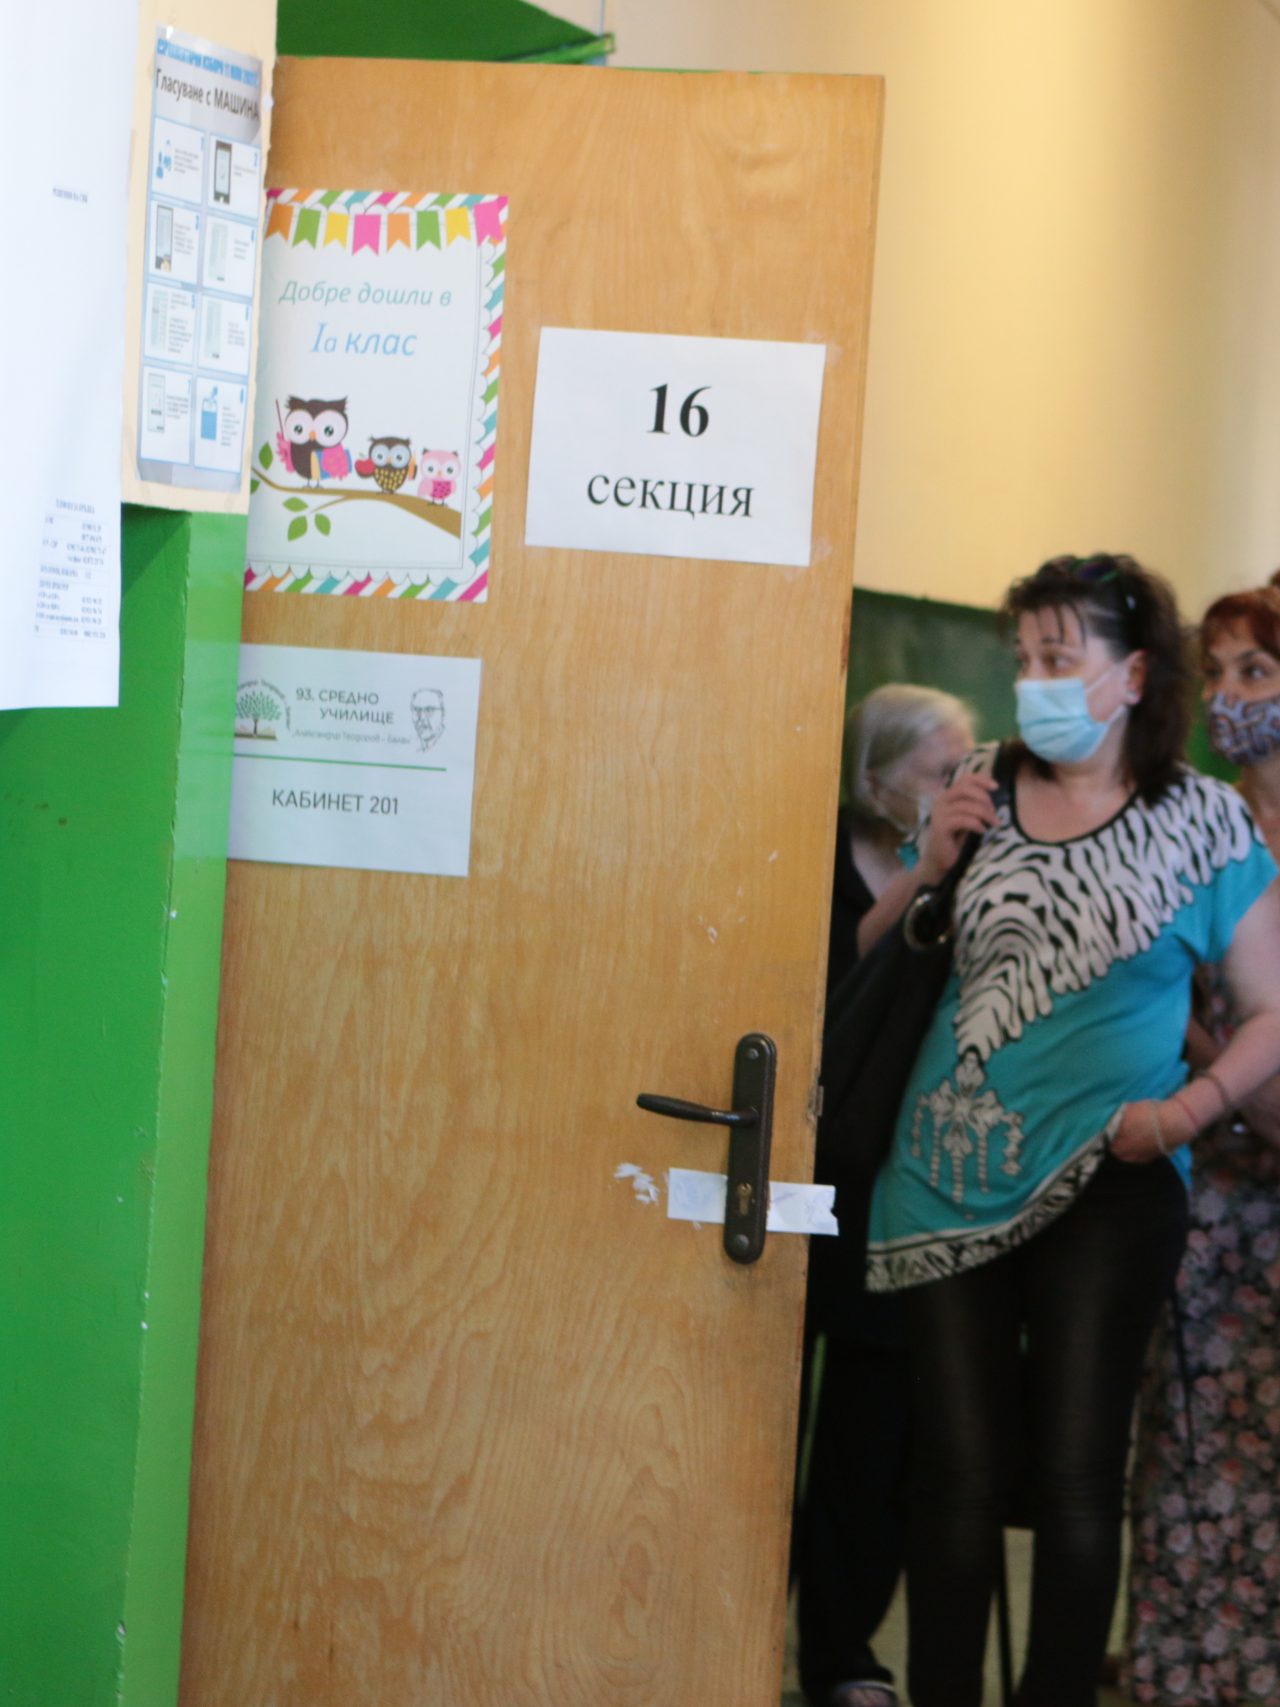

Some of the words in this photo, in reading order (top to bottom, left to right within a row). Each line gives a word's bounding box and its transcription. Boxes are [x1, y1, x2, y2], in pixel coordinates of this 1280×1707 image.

[155, 68, 204, 103] Гласуване
[214, 87, 260, 120] МАШИНА
[278, 280, 351, 307] Добре
[358, 282, 434, 307] дошли
[439, 290, 452, 307] в
[344, 331, 418, 356] клас
[646, 383, 712, 437] 16
[587, 474, 756, 520] секция
[295, 687, 315, 702] 93.
[318, 688, 380, 706] СРЕДНО
[319, 707, 395, 726] УЧИЛИЩЕ
[271, 788, 364, 813] КАБИНЕТ
[369, 796, 399, 815] 201
